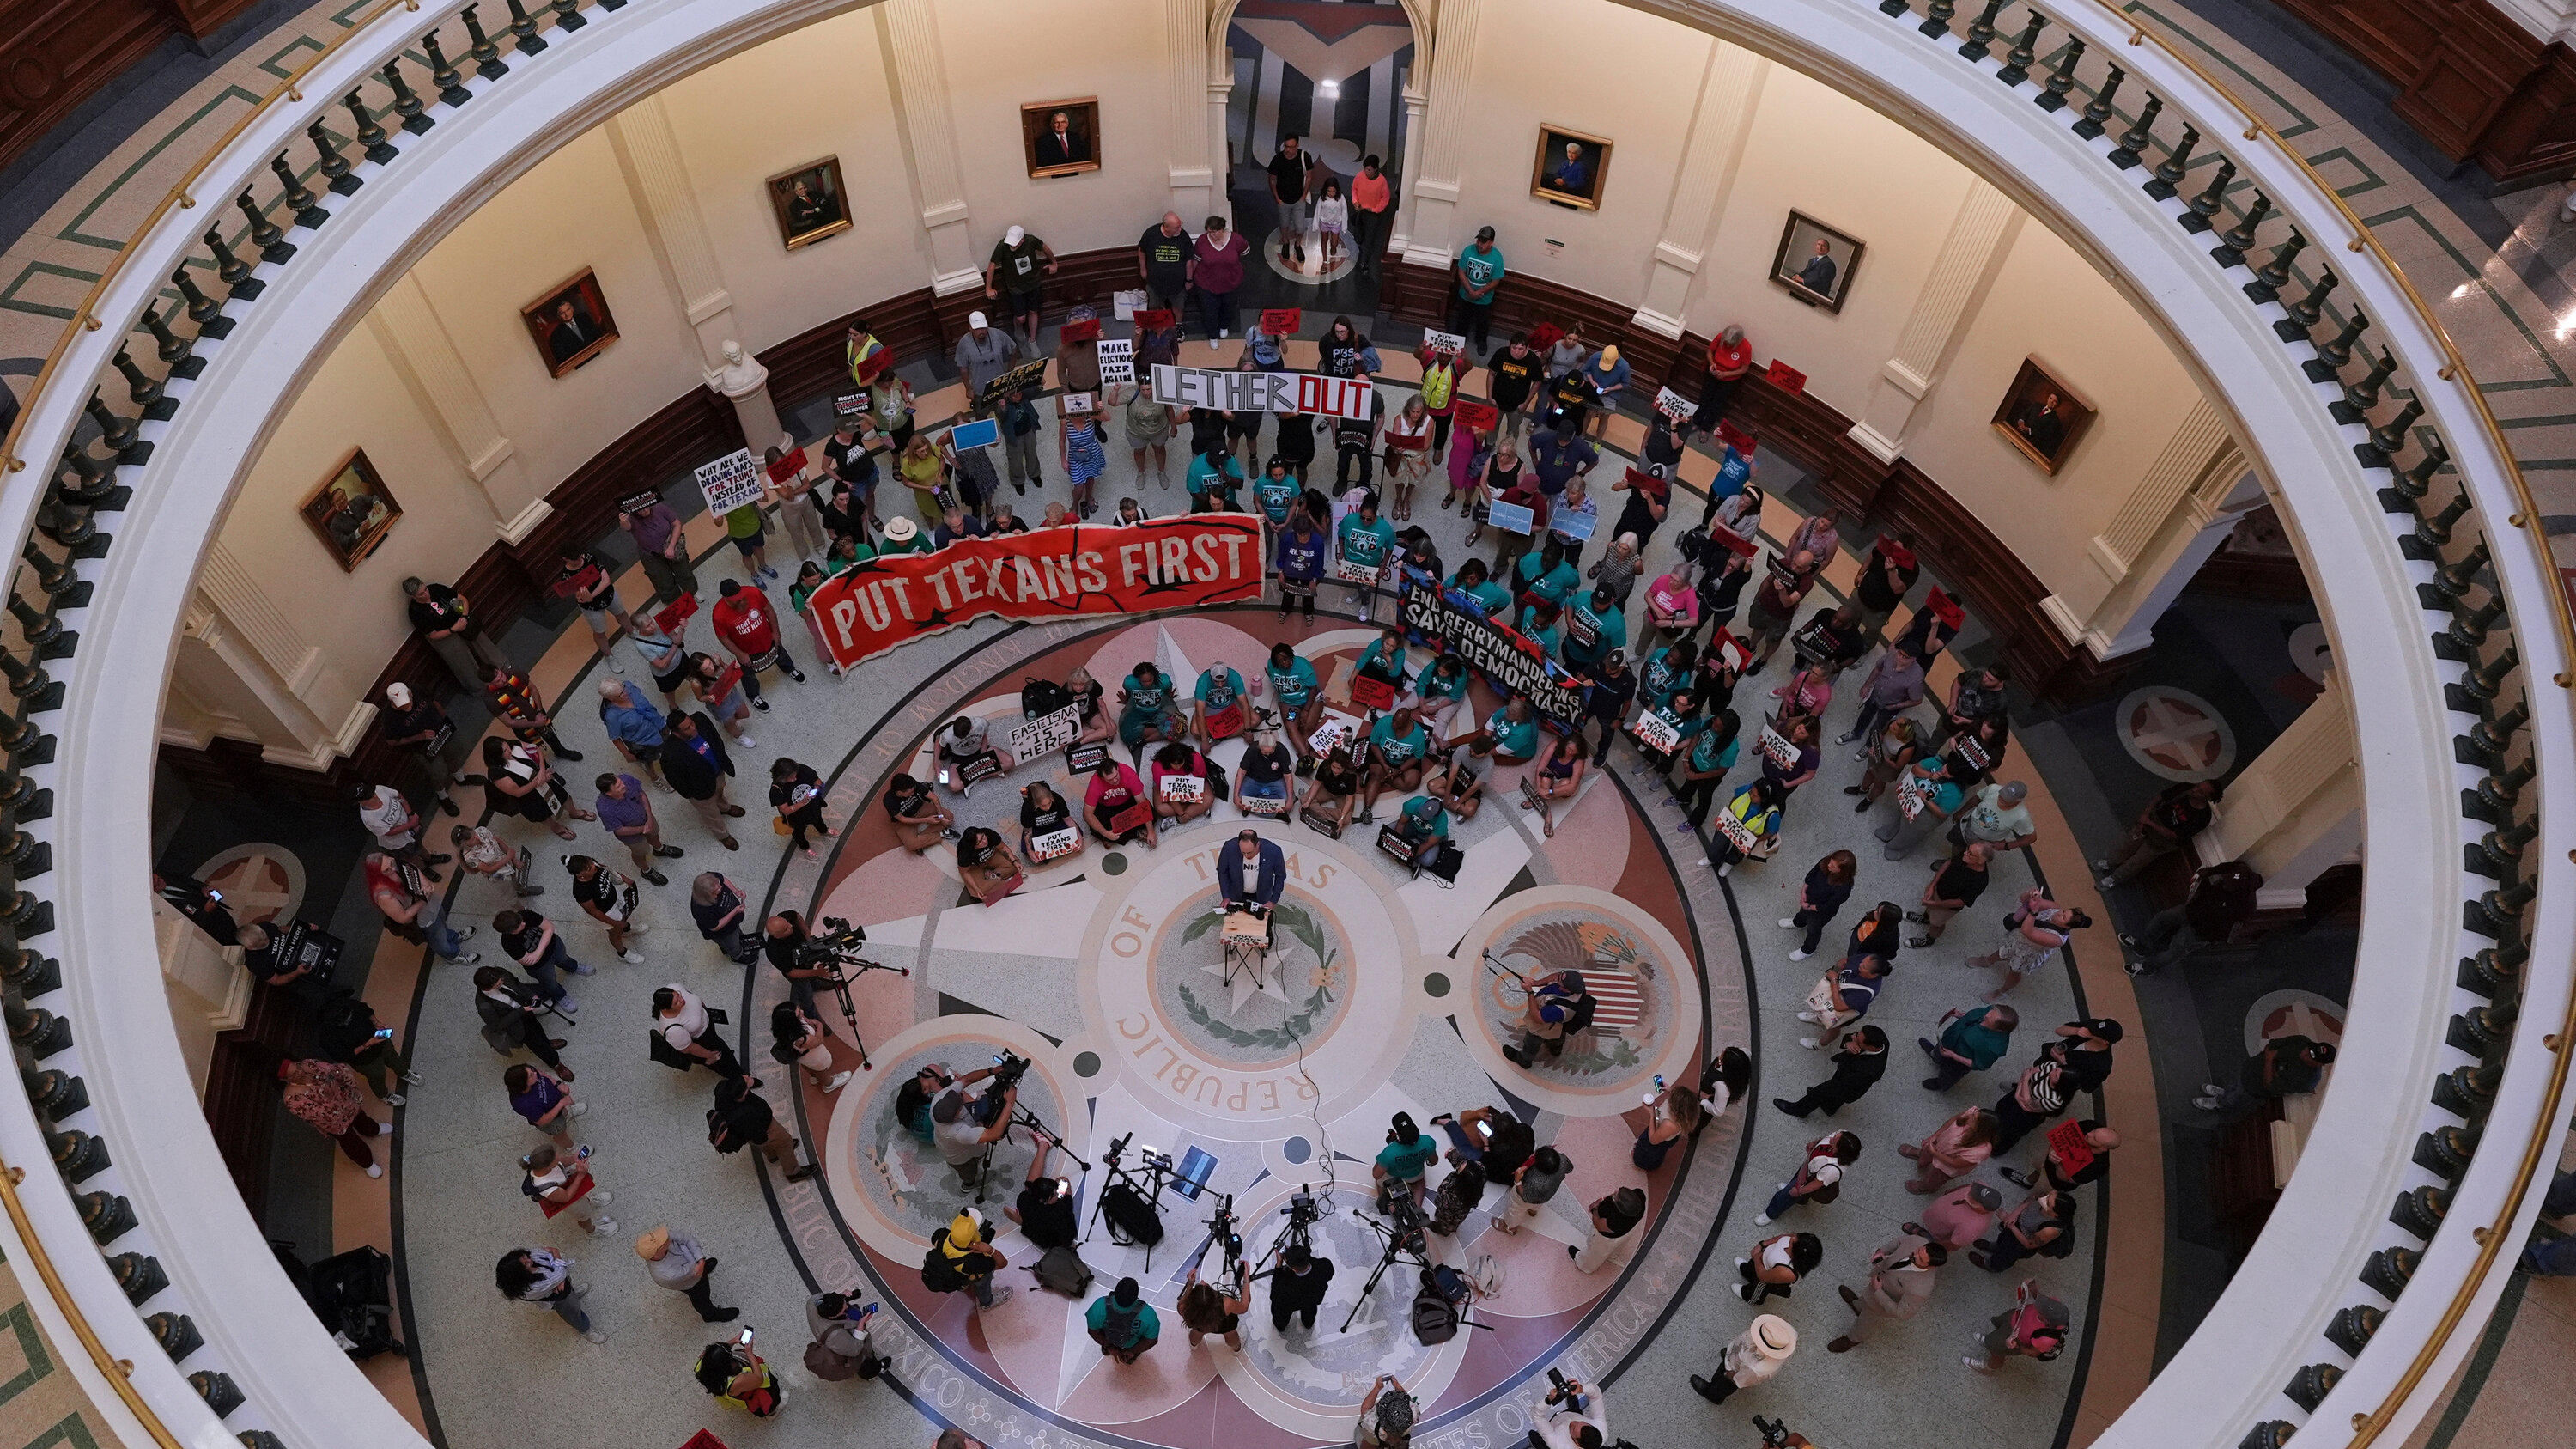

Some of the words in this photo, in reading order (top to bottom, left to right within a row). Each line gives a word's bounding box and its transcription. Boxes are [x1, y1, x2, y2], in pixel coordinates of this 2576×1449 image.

[1467, 260, 1491, 273] BLACK
[1467, 267, 1490, 280] TOP
[1101, 343, 1130, 354] MAKE
[1431, 336, 1458, 347] TEXANS
[1100, 353, 1133, 364] ELECTIONS
[993, 360, 1045, 387] DEFEND
[1103, 365, 1129, 374] FAIR
[1007, 372, 1026, 386] THE
[1104, 374, 1133, 384] AGAIN
[981, 372, 1044, 402] CONSTITUTION
[1154, 367, 1222, 408] LET
[1225, 373, 1296, 411] HER
[1298, 374, 1372, 419] OUT
[835, 396, 871, 411] TRUMP
[1664, 395, 1689, 413] TEXANS
[1672, 396, 1685, 405] PUT
[840, 405, 869, 415] TAKEOVER
[1340, 439, 1366, 448] TAKEOVER
[698, 463, 717, 478] WHY
[720, 457, 734, 469] ARE
[736, 452, 749, 462] WE
[701, 469, 732, 489] DRAWING
[733, 460, 754, 475] MAPS
[1203, 477, 1224, 485] BLAC
[708, 481, 726, 496] FOR
[729, 469, 754, 484] TRUMP
[712, 484, 744, 502] INSTEAD
[745, 478, 756, 487] OF
[622, 496, 639, 505] FIGHT
[712, 499, 729, 513] FOR
[729, 484, 762, 504] TEXANS
[1263, 495, 1290, 506] TOP
[627, 499, 658, 514] TAKEOVER
[1348, 538, 1376, 552] TOP
[1349, 531, 1379, 544] BLACK
[1345, 566, 1372, 576] TEXANS
[830, 576, 915, 650] PUT
[924, 551, 1108, 612] TEXANS
[1118, 533, 1249, 588] FIRST
[1410, 585, 1440, 613] END
[736, 618, 750, 631] FIGHT
[738, 625, 752, 636] LIKE
[1406, 605, 1455, 645] SAVE
[1460, 638, 1580, 723] DEMOCRACY
[1646, 720, 1671, 740] TEXANS
[1654, 720, 1668, 731] PUT
[1034, 728, 1053, 744] IS
[1315, 729, 1326, 739] PUT
[1315, 728, 1335, 747] TEXANS
[1322, 734, 1335, 748] FIRST
[1774, 736, 1787, 747] PUT
[1072, 748, 1102, 758] TAKEOVER
[1382, 740, 1412, 754] BLACK
[1767, 734, 1792, 758] TEXANS
[1968, 734, 1980, 750] FIGHT
[1980, 749, 1991, 761] THE
[963, 761, 979, 771] FIGHT
[980, 756, 991, 764] THE
[1958, 744, 1979, 770] TAKEOVER
[967, 766, 996, 781] TAKEOVER
[1725, 817, 1747, 842] TEXANS
[1732, 819, 1744, 831] PUT
[1041, 835, 1072, 848] TEXANS
[1048, 833, 1062, 842] PUT
[1386, 832, 1400, 844] FIGHT
[1400, 841, 1413, 851] THE
[1047, 842, 1066, 851] FIRST
[1382, 843, 1408, 861] TAKEOVER
[1183, 849, 1337, 889] TAS
[1111, 905, 1151, 958] OF
[283, 946, 295, 966] SCAN
[291, 925, 303, 947] HERE
[1116, 1013, 1317, 1111] REPUBLIC
[864, 1314, 965, 1409] MEXICO
